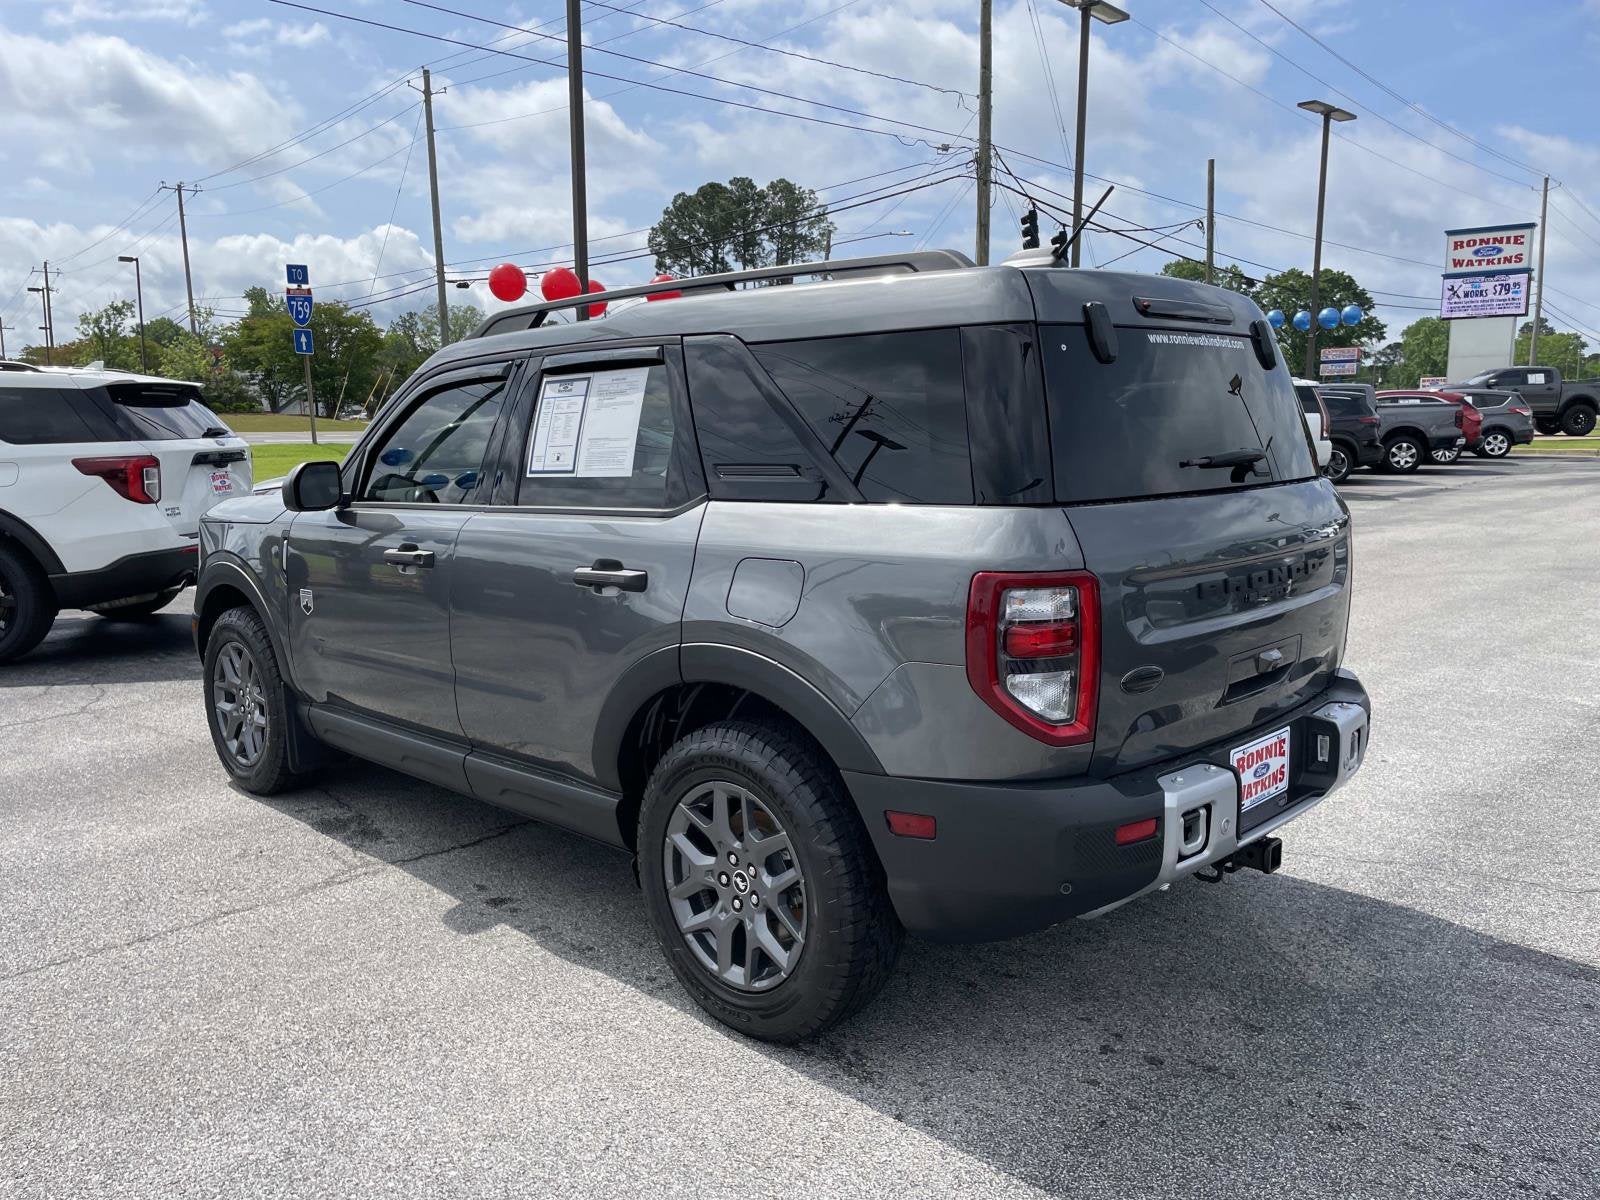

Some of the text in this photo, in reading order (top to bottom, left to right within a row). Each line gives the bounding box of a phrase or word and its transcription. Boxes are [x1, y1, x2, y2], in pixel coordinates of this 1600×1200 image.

[1452, 234, 1525, 251] RONNIE
[1452, 253, 1524, 268] WATKINS
[291, 268, 303, 281] TO
[1463, 289, 1489, 298] WORKS
[290, 301, 310, 319] 759
[1147, 333, 1245, 349] www.ronniewatkinsford.com
[1236, 738, 1286, 774] RONNIE
